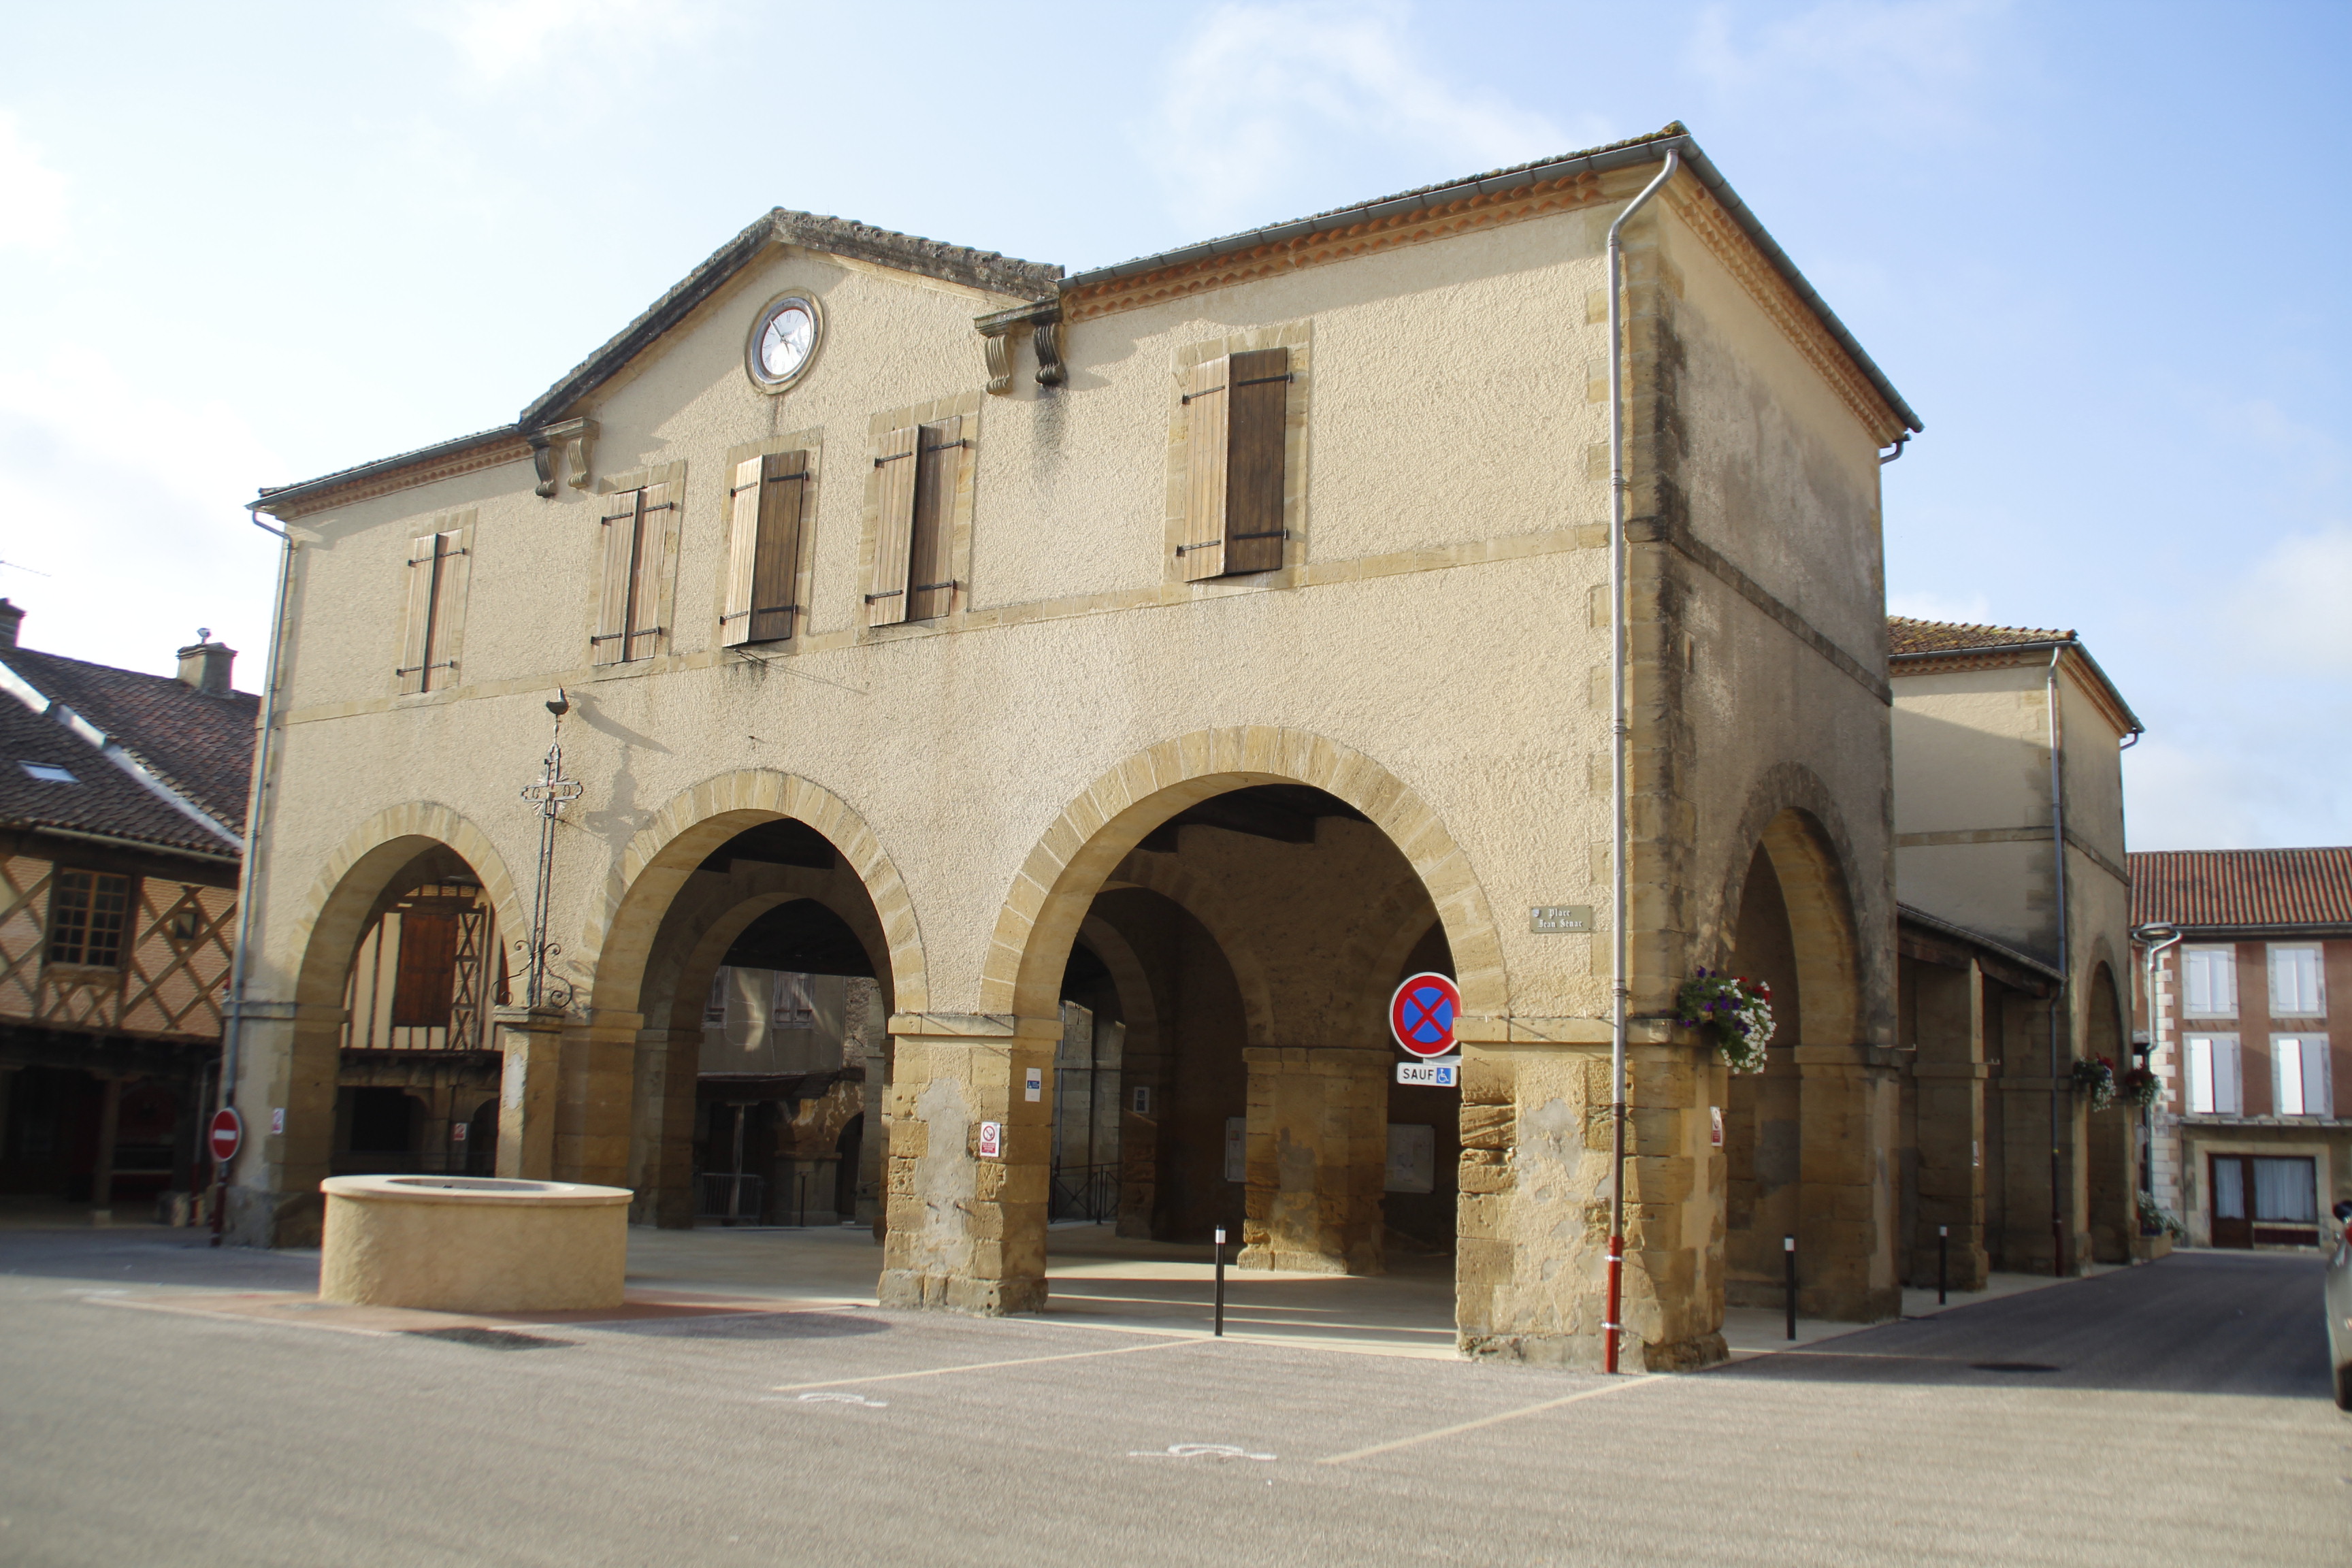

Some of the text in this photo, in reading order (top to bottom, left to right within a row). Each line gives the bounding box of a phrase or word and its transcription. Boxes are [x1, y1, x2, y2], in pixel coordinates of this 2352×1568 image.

[1548, 908, 1571, 919] Place
[1538, 919, 1556, 928] Jean
[1403, 1068, 1434, 1080] SAUF
